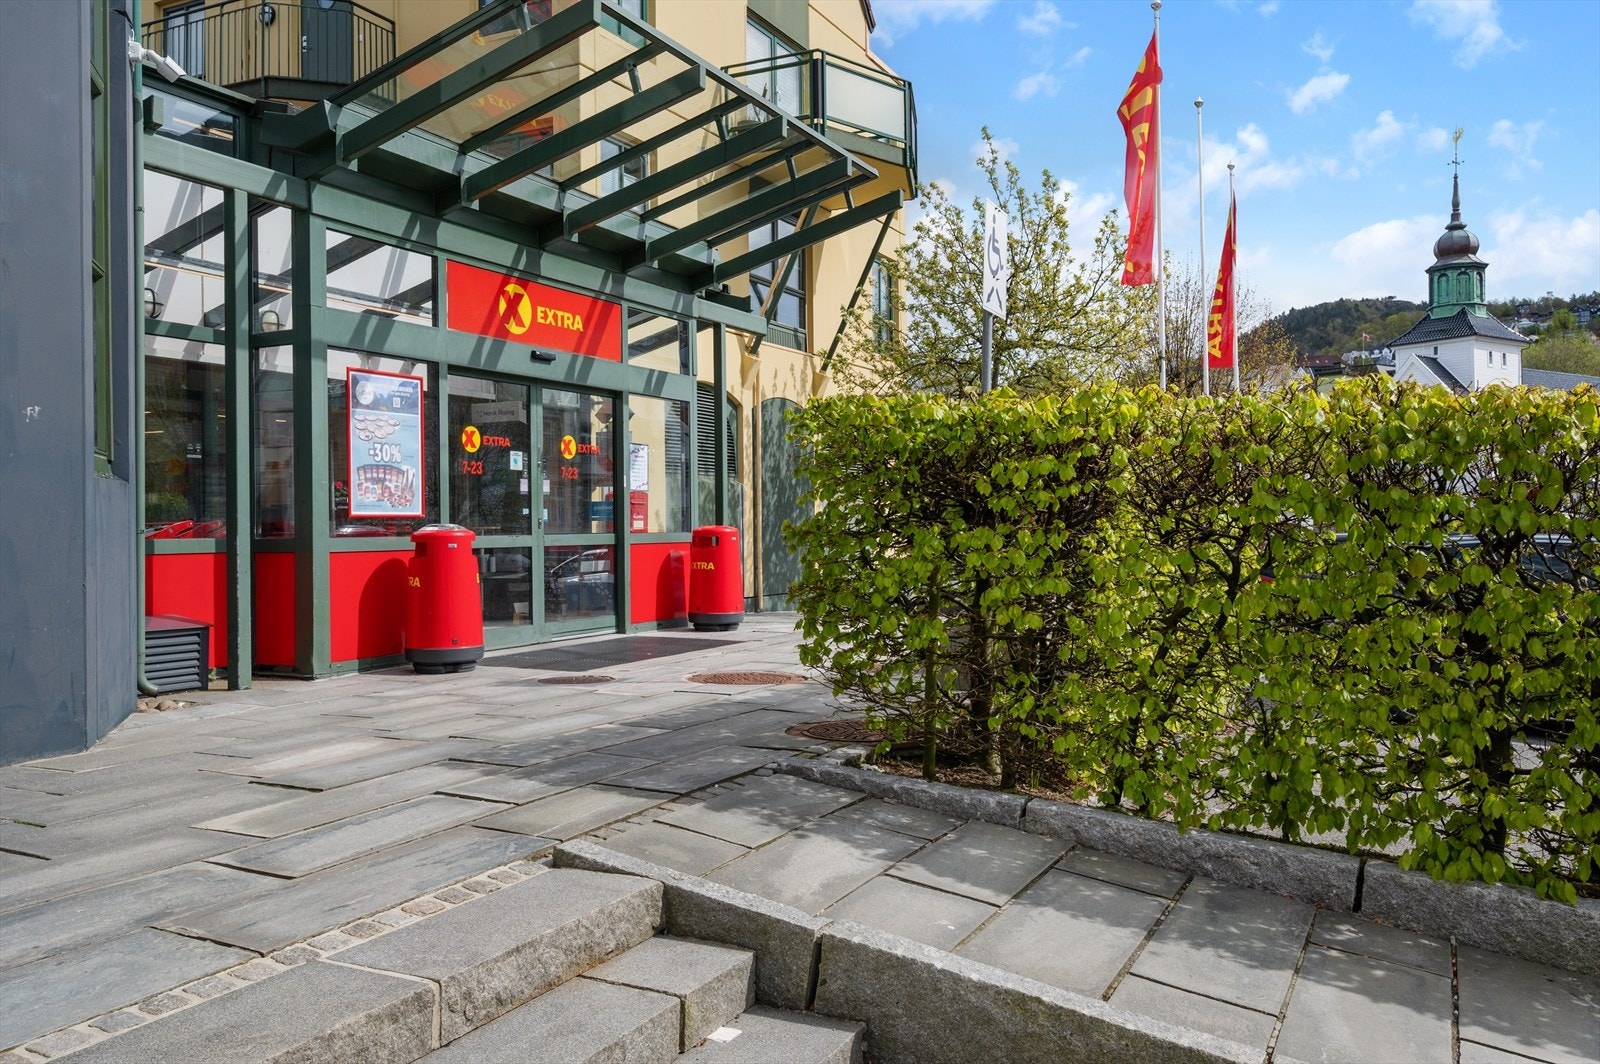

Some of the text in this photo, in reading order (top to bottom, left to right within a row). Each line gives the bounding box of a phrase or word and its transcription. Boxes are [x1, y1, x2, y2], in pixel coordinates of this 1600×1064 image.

[537, 306, 583, 332] EXTRA
[483, 435, 511, 447] EXTRA
[369, 443, 402, 463] -30%
[578, 444, 600, 454] EXTRA
[462, 461, 483, 475] 7-23
[561, 467, 578, 480] 7-23
